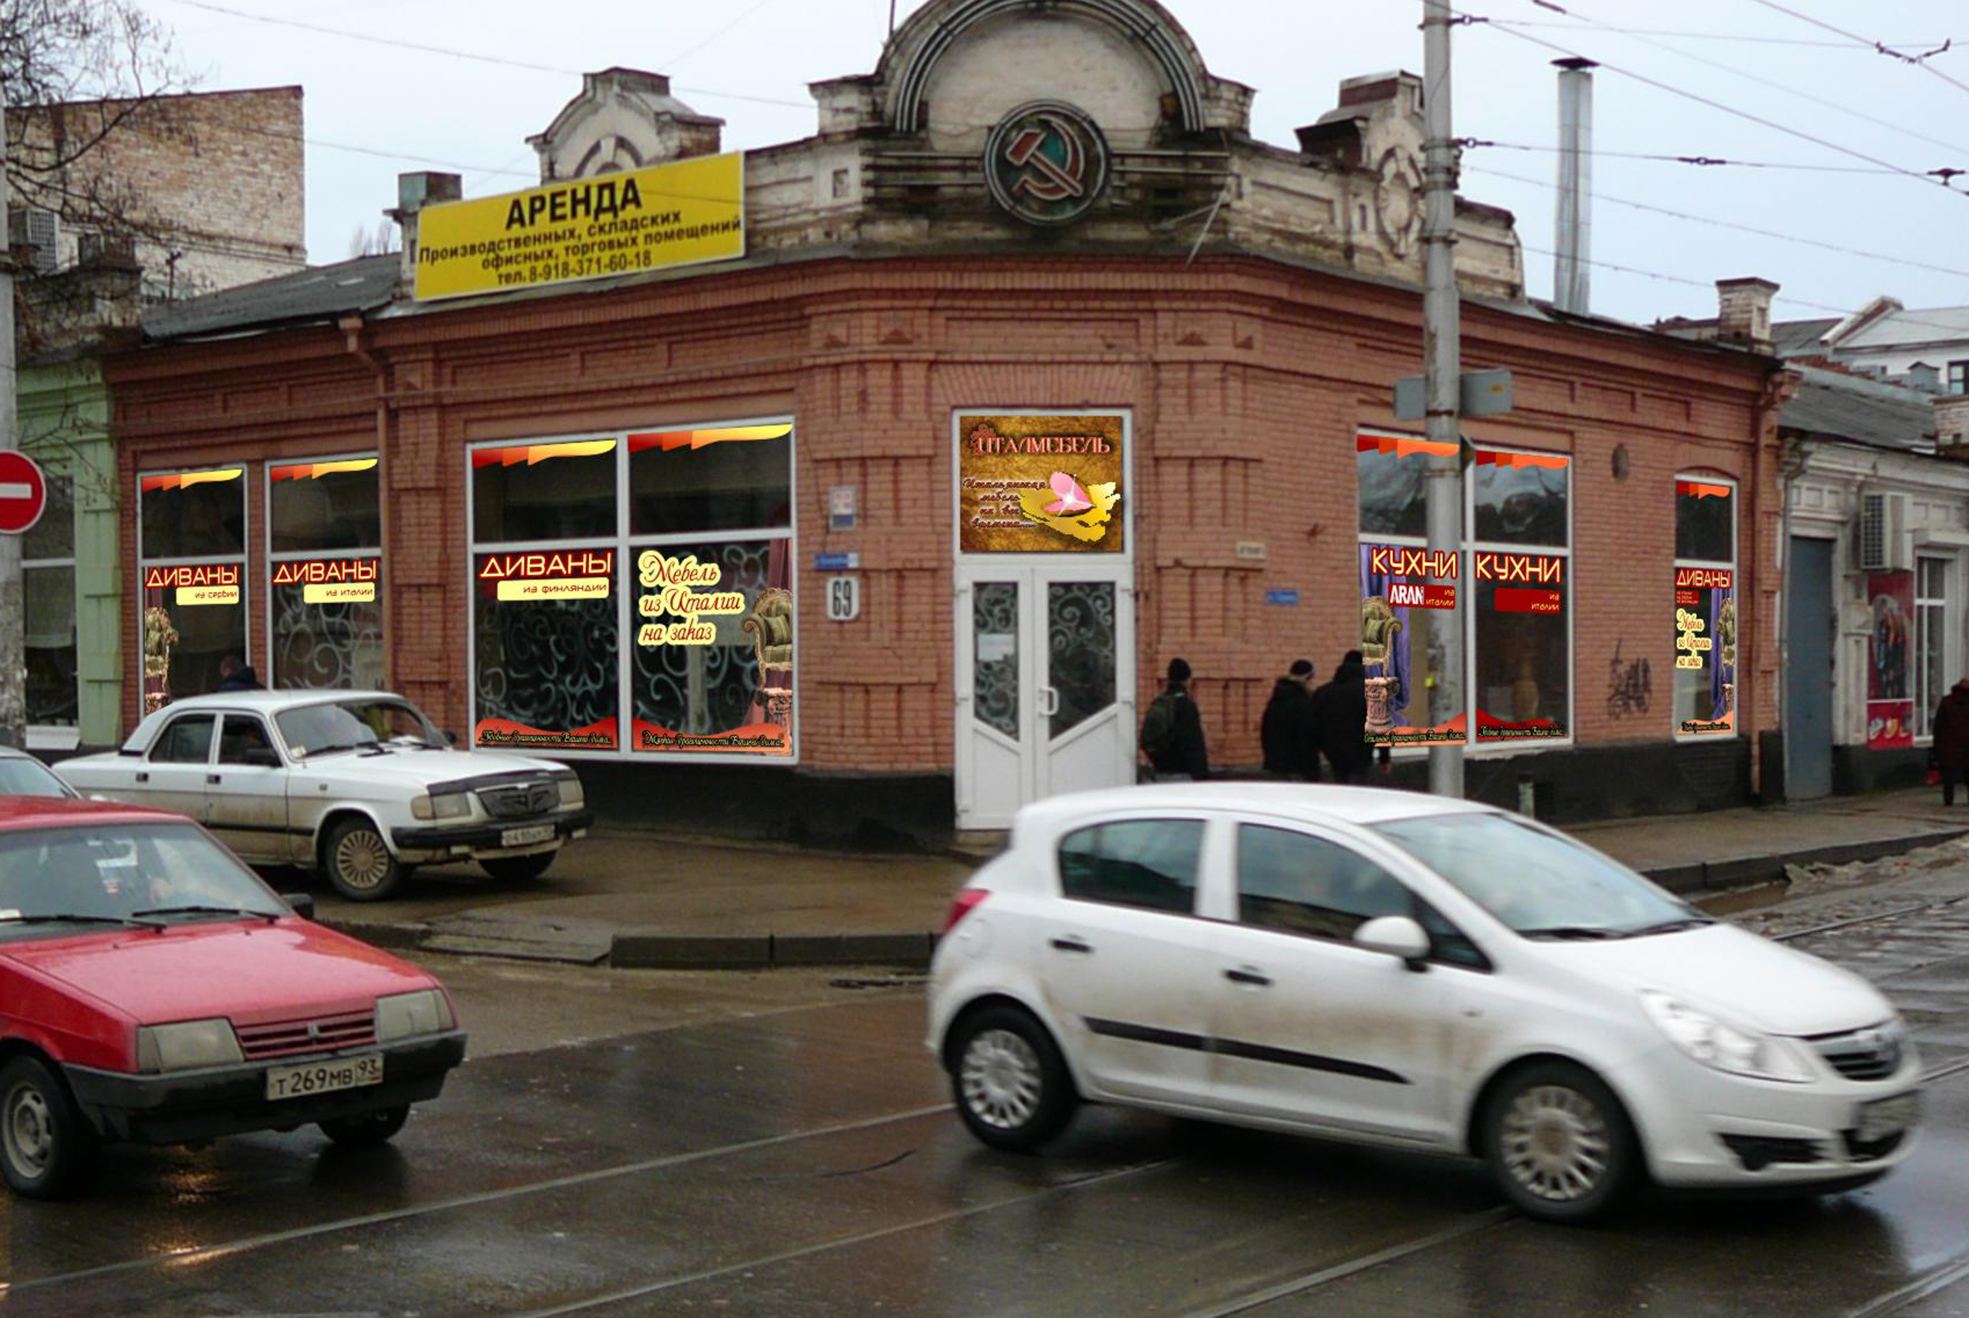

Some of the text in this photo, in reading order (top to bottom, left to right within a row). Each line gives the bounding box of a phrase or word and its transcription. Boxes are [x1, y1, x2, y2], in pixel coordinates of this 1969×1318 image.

[505, 178, 642, 230] АРЕНДА
[419, 211, 681, 264] Производственных, складских
[481, 216, 741, 270] офисных, торговых помещений
[272, 561, 378, 583] ДИВАНЫ
[480, 552, 612, 578] ДИВАНЫ
[641, 554, 718, 584] Мебель
[1372, 549, 1457, 578] КУХНИ
[1476, 554, 1561, 583] КУХНИ
[146, 565, 239, 587] ДИВАНЫ
[1676, 569, 1731, 588] ДИВАНЫ
[208, 590, 238, 599] сербии
[341, 588, 374, 597] италии
[523, 583, 608, 595] из финляндии
[832, 580, 853, 617] 69
[1389, 585, 1424, 605] ARAN
[1549, 593, 1560, 601] из
[643, 588, 742, 613] из Италии
[1425, 599, 1455, 607] италии
[1531, 603, 1560, 611] италии
[643, 618, 713, 641] на заказ
[359, 1060, 377, 1075] 93
